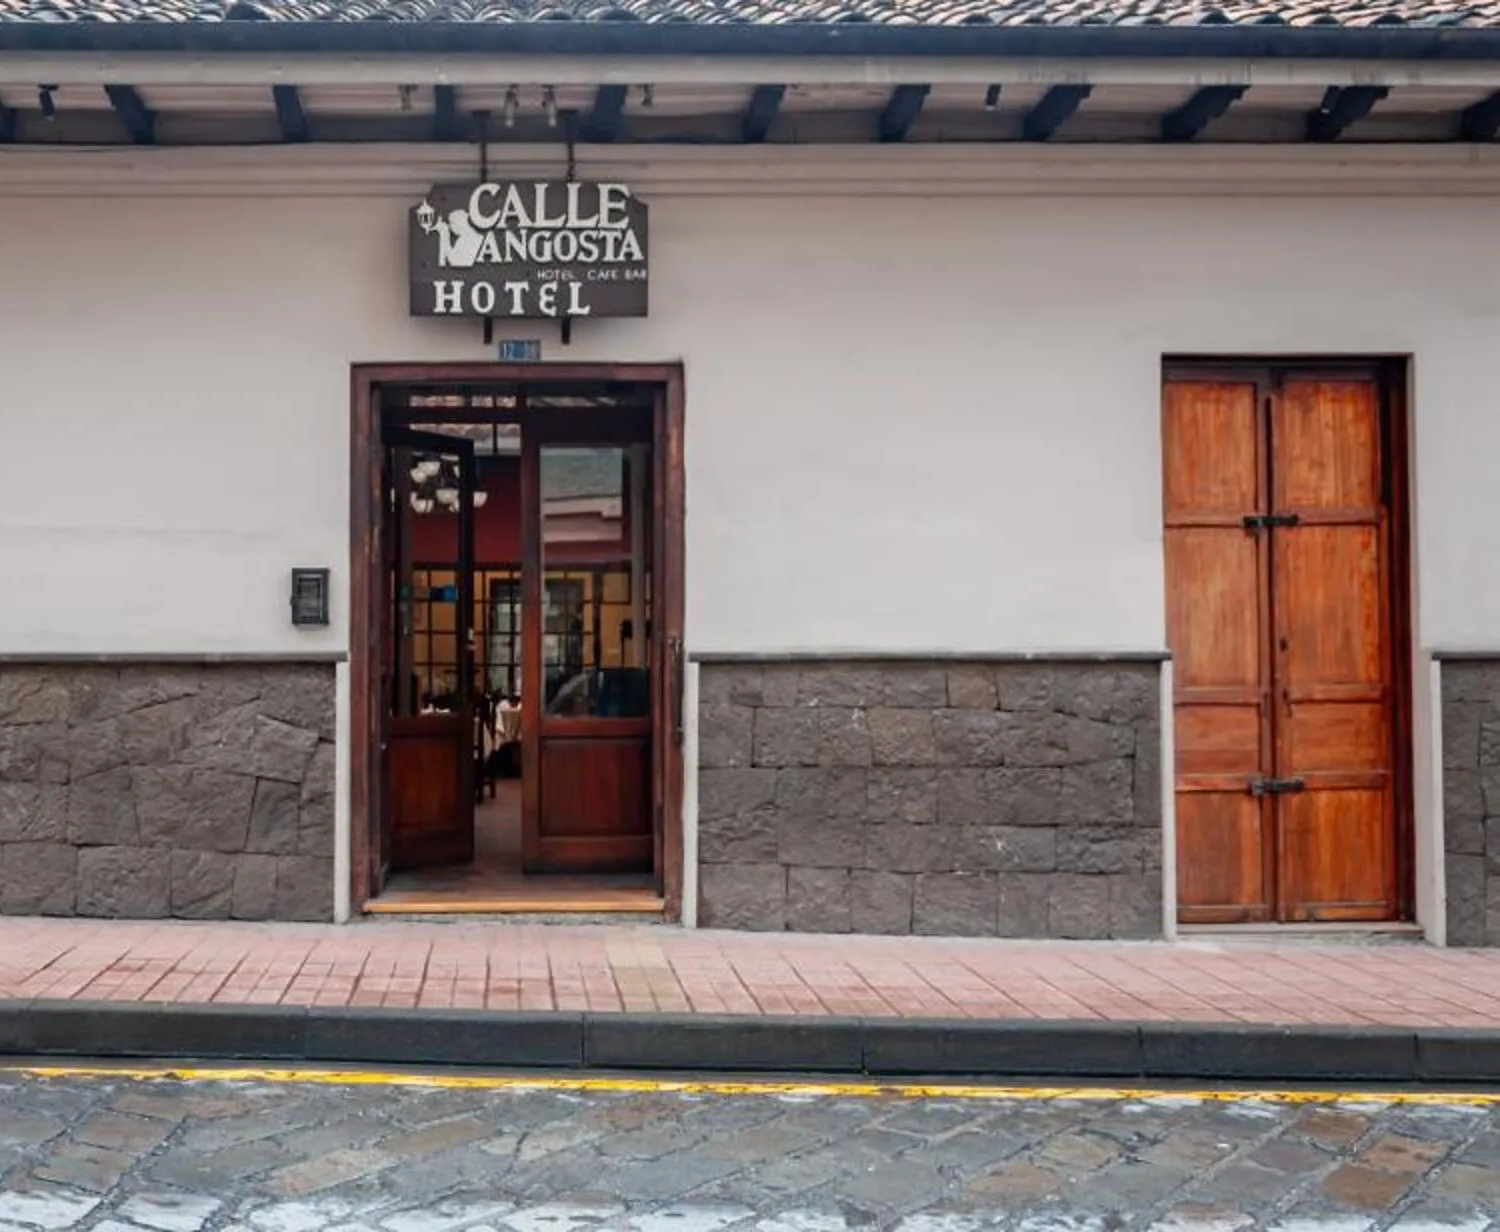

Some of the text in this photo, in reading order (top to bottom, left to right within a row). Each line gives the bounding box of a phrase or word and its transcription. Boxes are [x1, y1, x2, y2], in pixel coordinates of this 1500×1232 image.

[468, 182, 630, 229] CALLE
[475, 228, 645, 263] ANGOSTA
[433, 280, 591, 316] HOTEL
